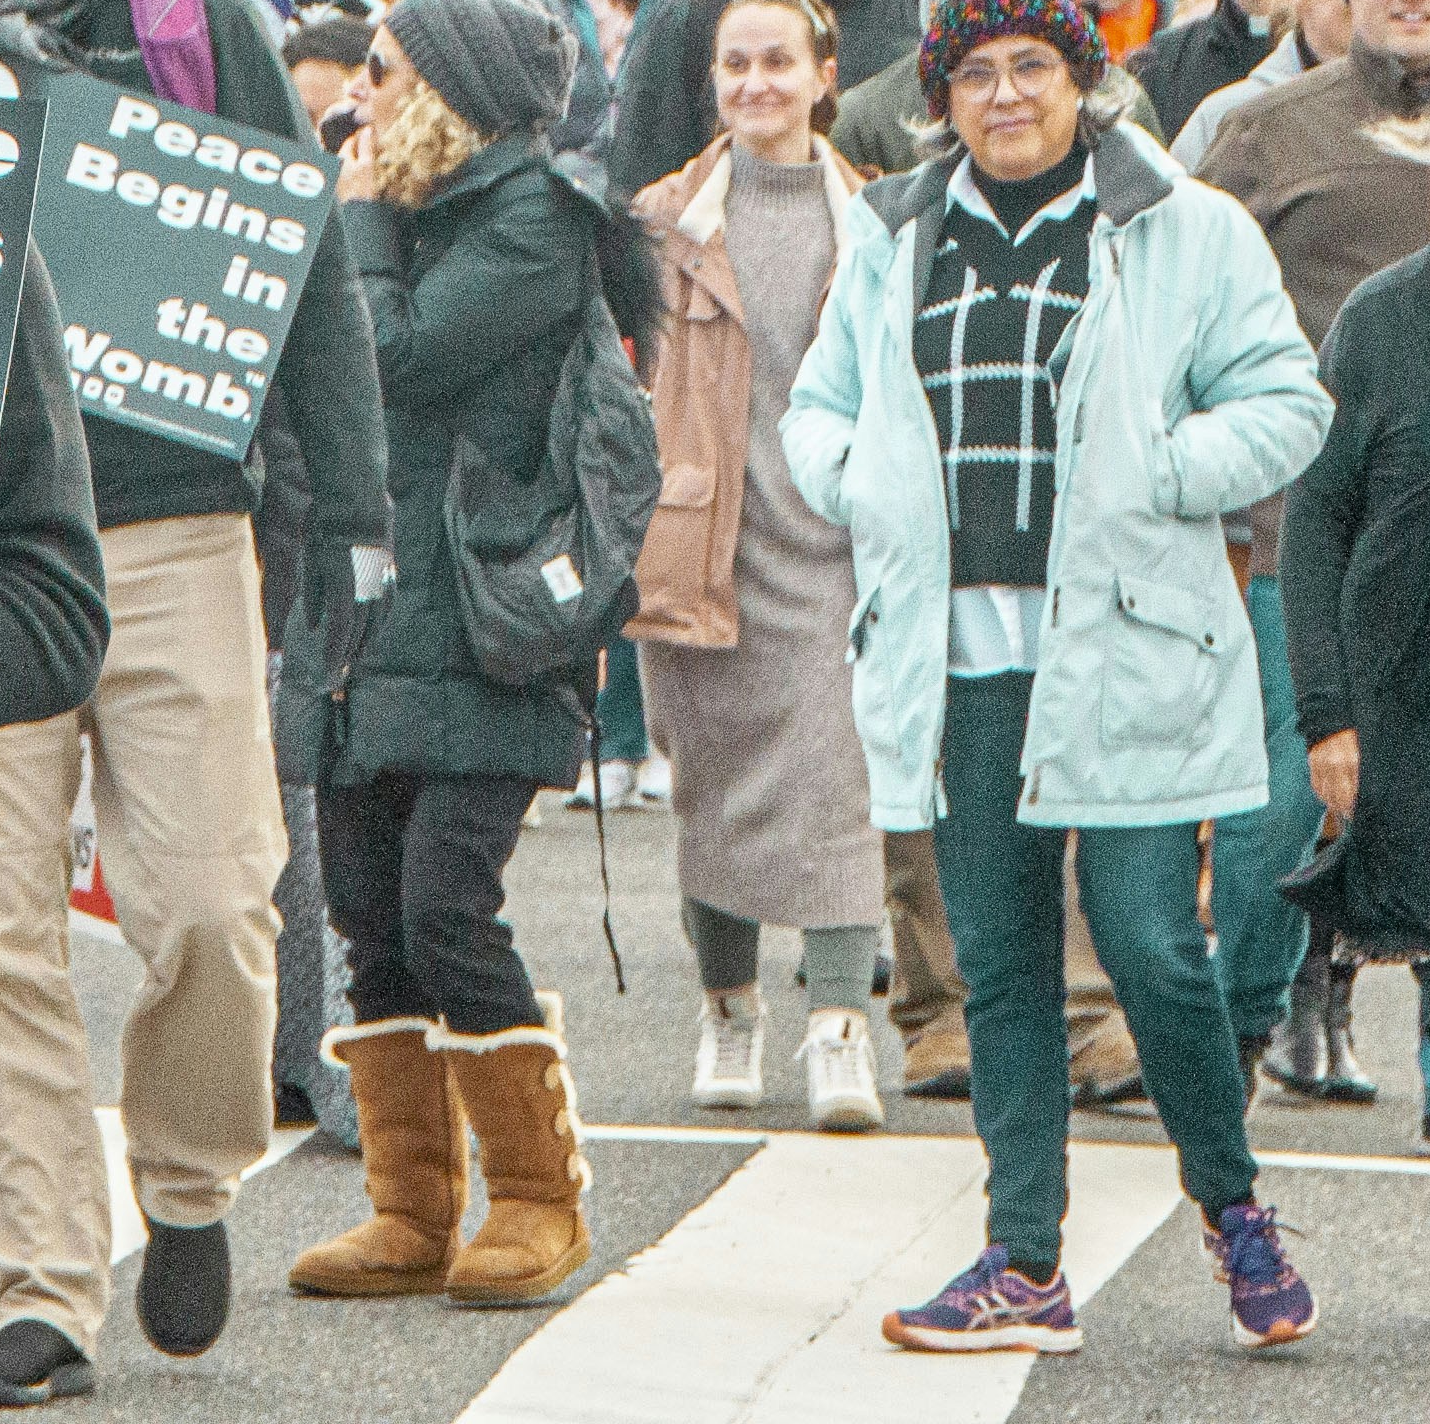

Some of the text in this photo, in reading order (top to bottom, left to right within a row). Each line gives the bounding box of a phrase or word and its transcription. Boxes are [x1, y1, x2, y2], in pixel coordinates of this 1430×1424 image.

[108, 94, 326, 198] Peace
[65, 142, 307, 255] Begins
[222, 254, 289, 311] in
[156, 296, 269, 364] the
